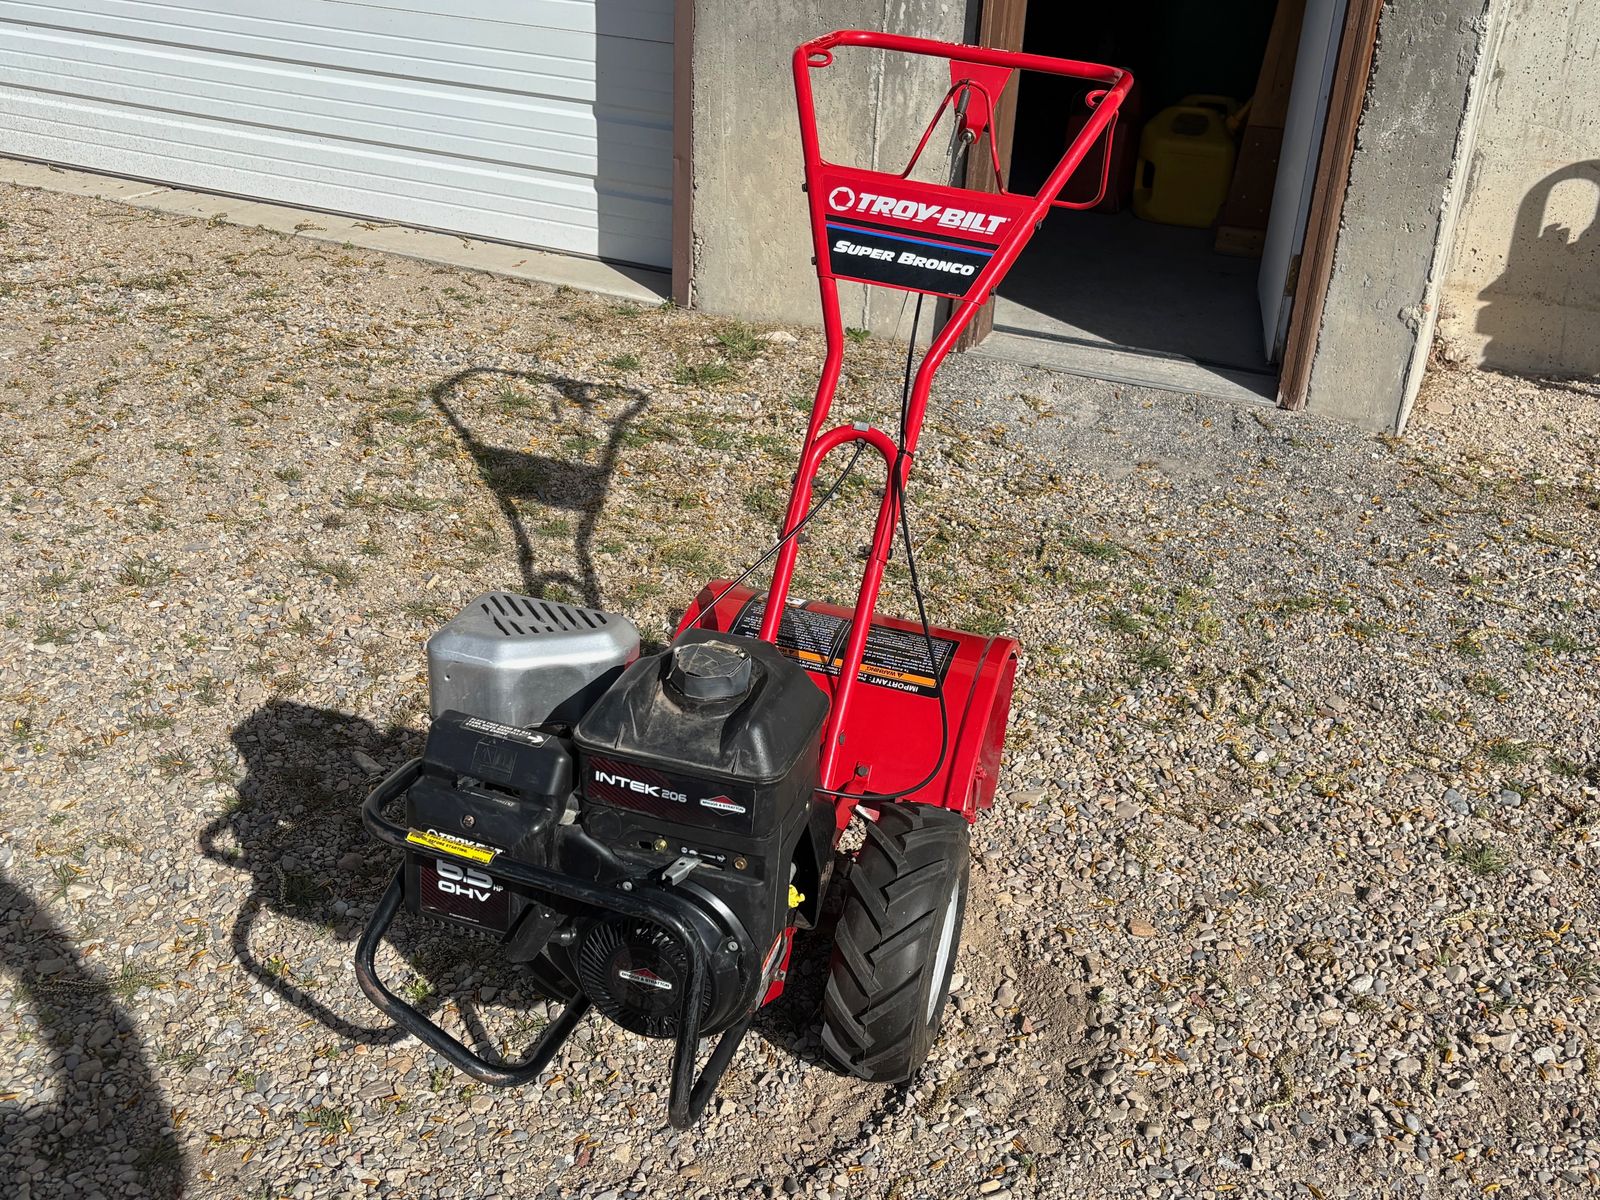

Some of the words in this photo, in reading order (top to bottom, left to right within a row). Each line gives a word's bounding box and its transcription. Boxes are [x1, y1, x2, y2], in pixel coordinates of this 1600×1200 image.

[856, 193, 1007, 235] TROY-BILT
[833, 240, 895, 262] SUPER
[897, 252, 975, 276] BRONCO
[866, 666, 896, 677] WARNING
[869, 676, 919, 692] IMPORTANT:
[595, 770, 661, 798] INTEK
[661, 789, 687, 803] 206
[437, 880, 491, 902] OHV
